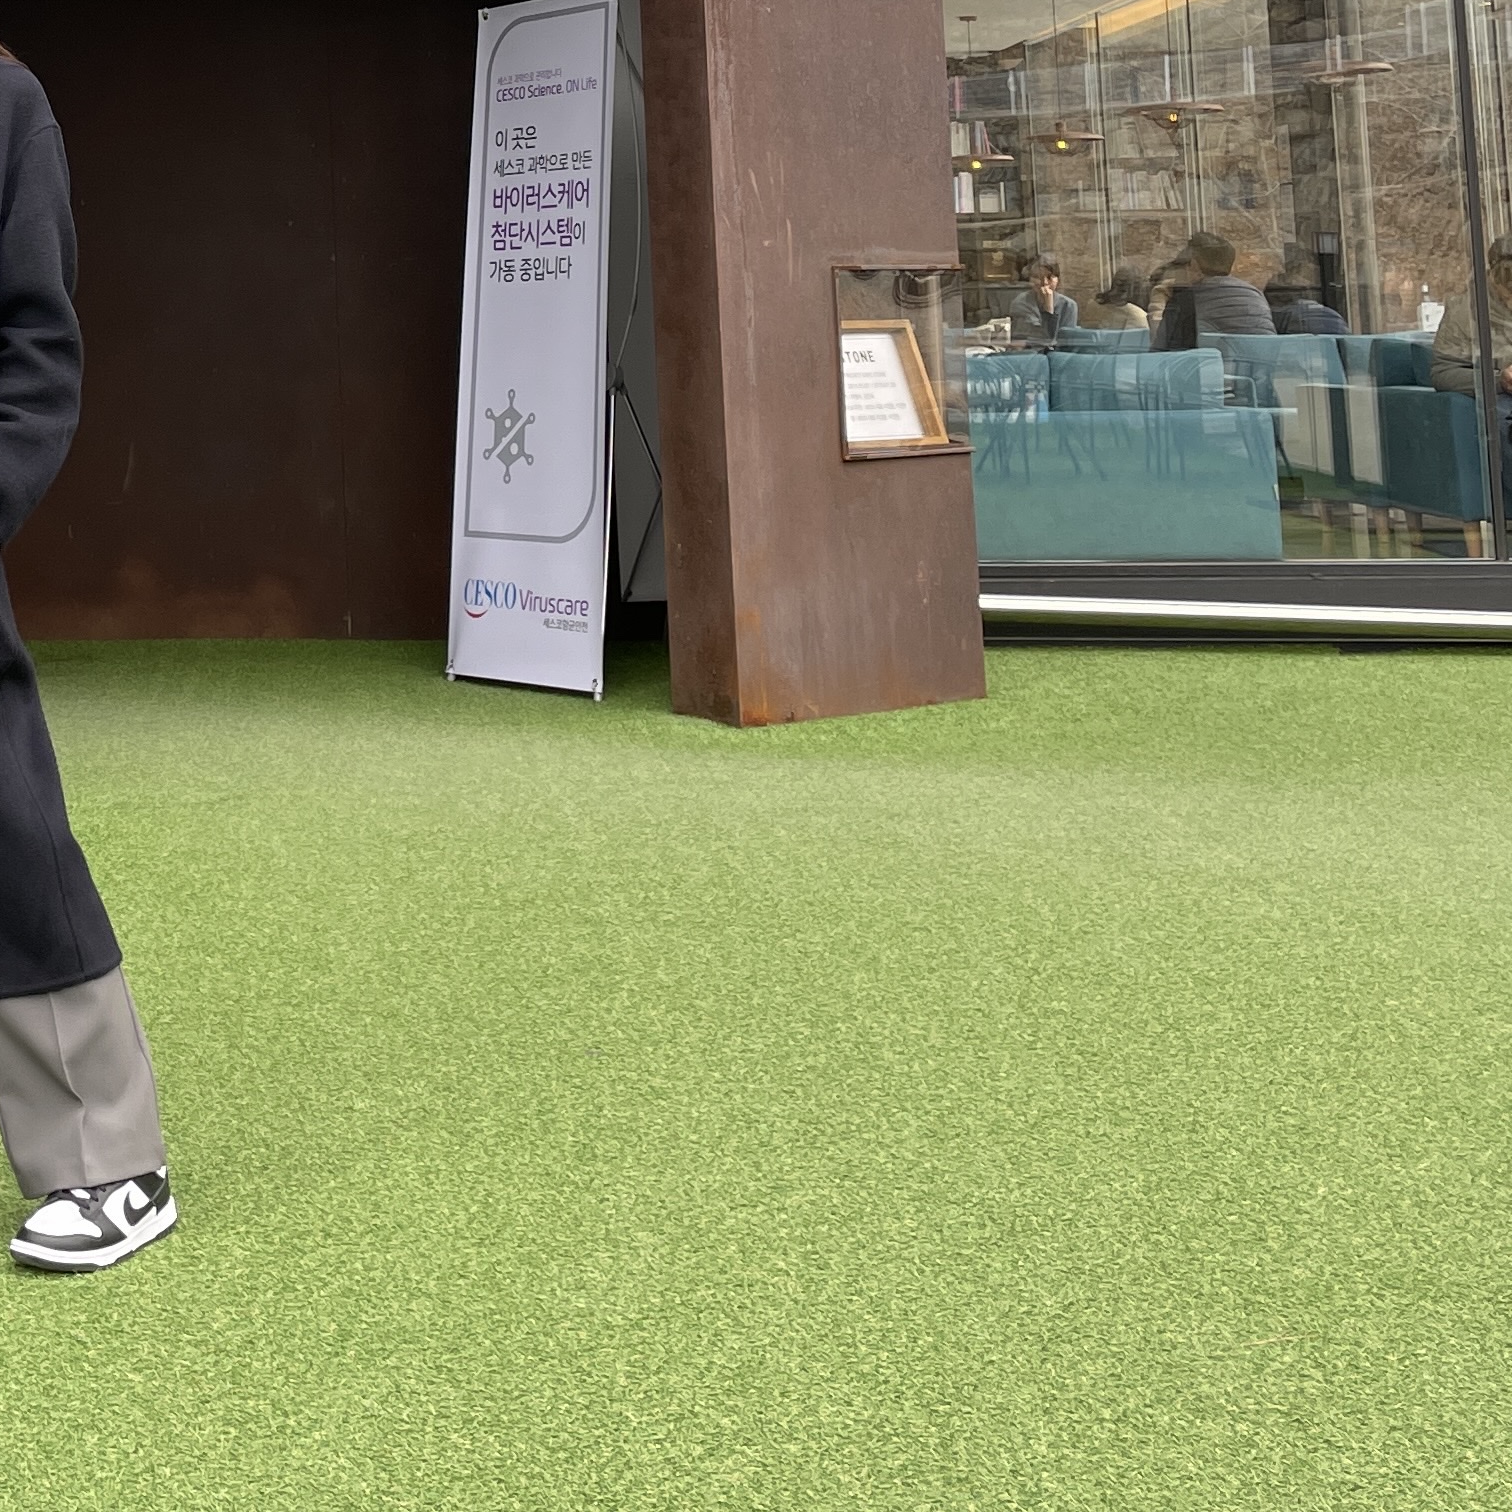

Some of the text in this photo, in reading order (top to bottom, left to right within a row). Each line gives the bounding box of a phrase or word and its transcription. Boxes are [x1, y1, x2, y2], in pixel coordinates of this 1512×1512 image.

[496, 86, 526, 103] CESCO
[566, 79, 580, 94] ON
[581, 76, 597, 91] Life
[495, 125, 538, 152] 이 곳은
[493, 149, 593, 178] 세스코 과학으로 만든
[493, 177, 590, 215] 바이러스케어
[491, 216, 586, 251] 첨단시스템이
[489, 255, 573, 283] 가동 중입니다
[841, 350, 875, 364] TONE
[464, 578, 589, 617] CESCO Viruscare
